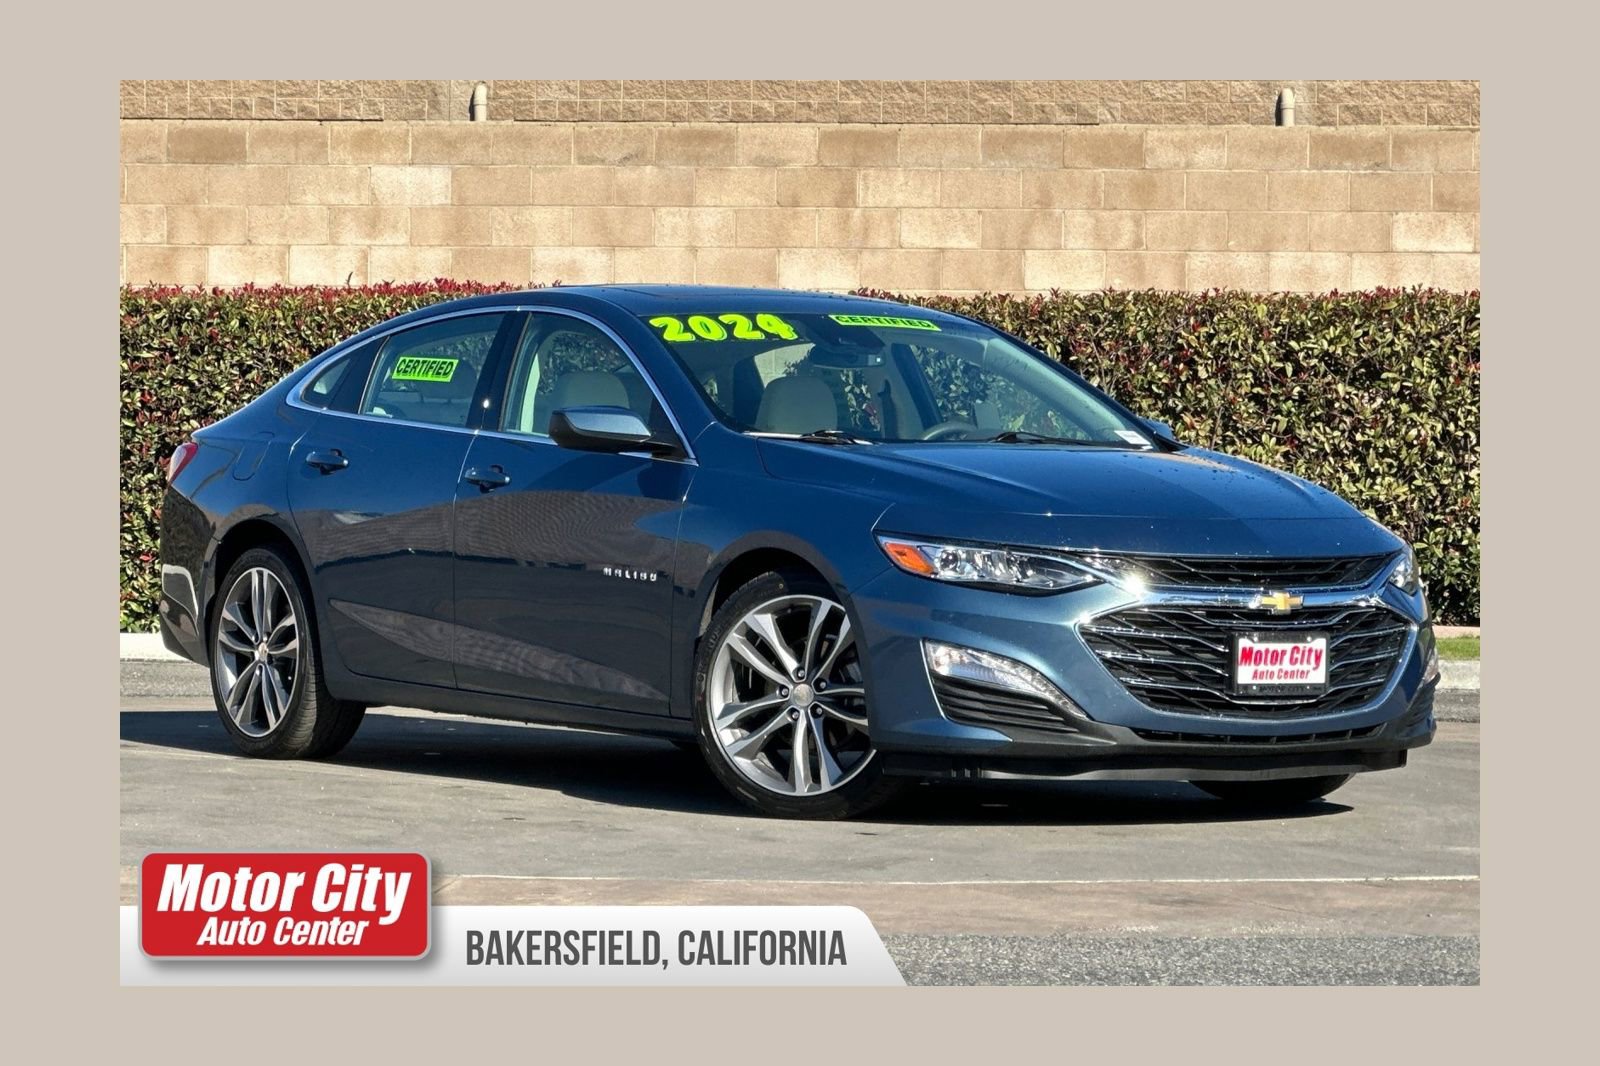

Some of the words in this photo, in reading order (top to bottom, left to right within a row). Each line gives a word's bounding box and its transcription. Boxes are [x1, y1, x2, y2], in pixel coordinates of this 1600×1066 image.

[649, 314, 798, 341] 2024
[835, 315, 933, 329] CERTIFIED
[396, 358, 454, 377] CERTIFIED
[1239, 646, 1287, 667] Motor
[1289, 645, 1323, 671] City
[1252, 668, 1275, 681] Auto
[1276, 668, 1310, 680] Center
